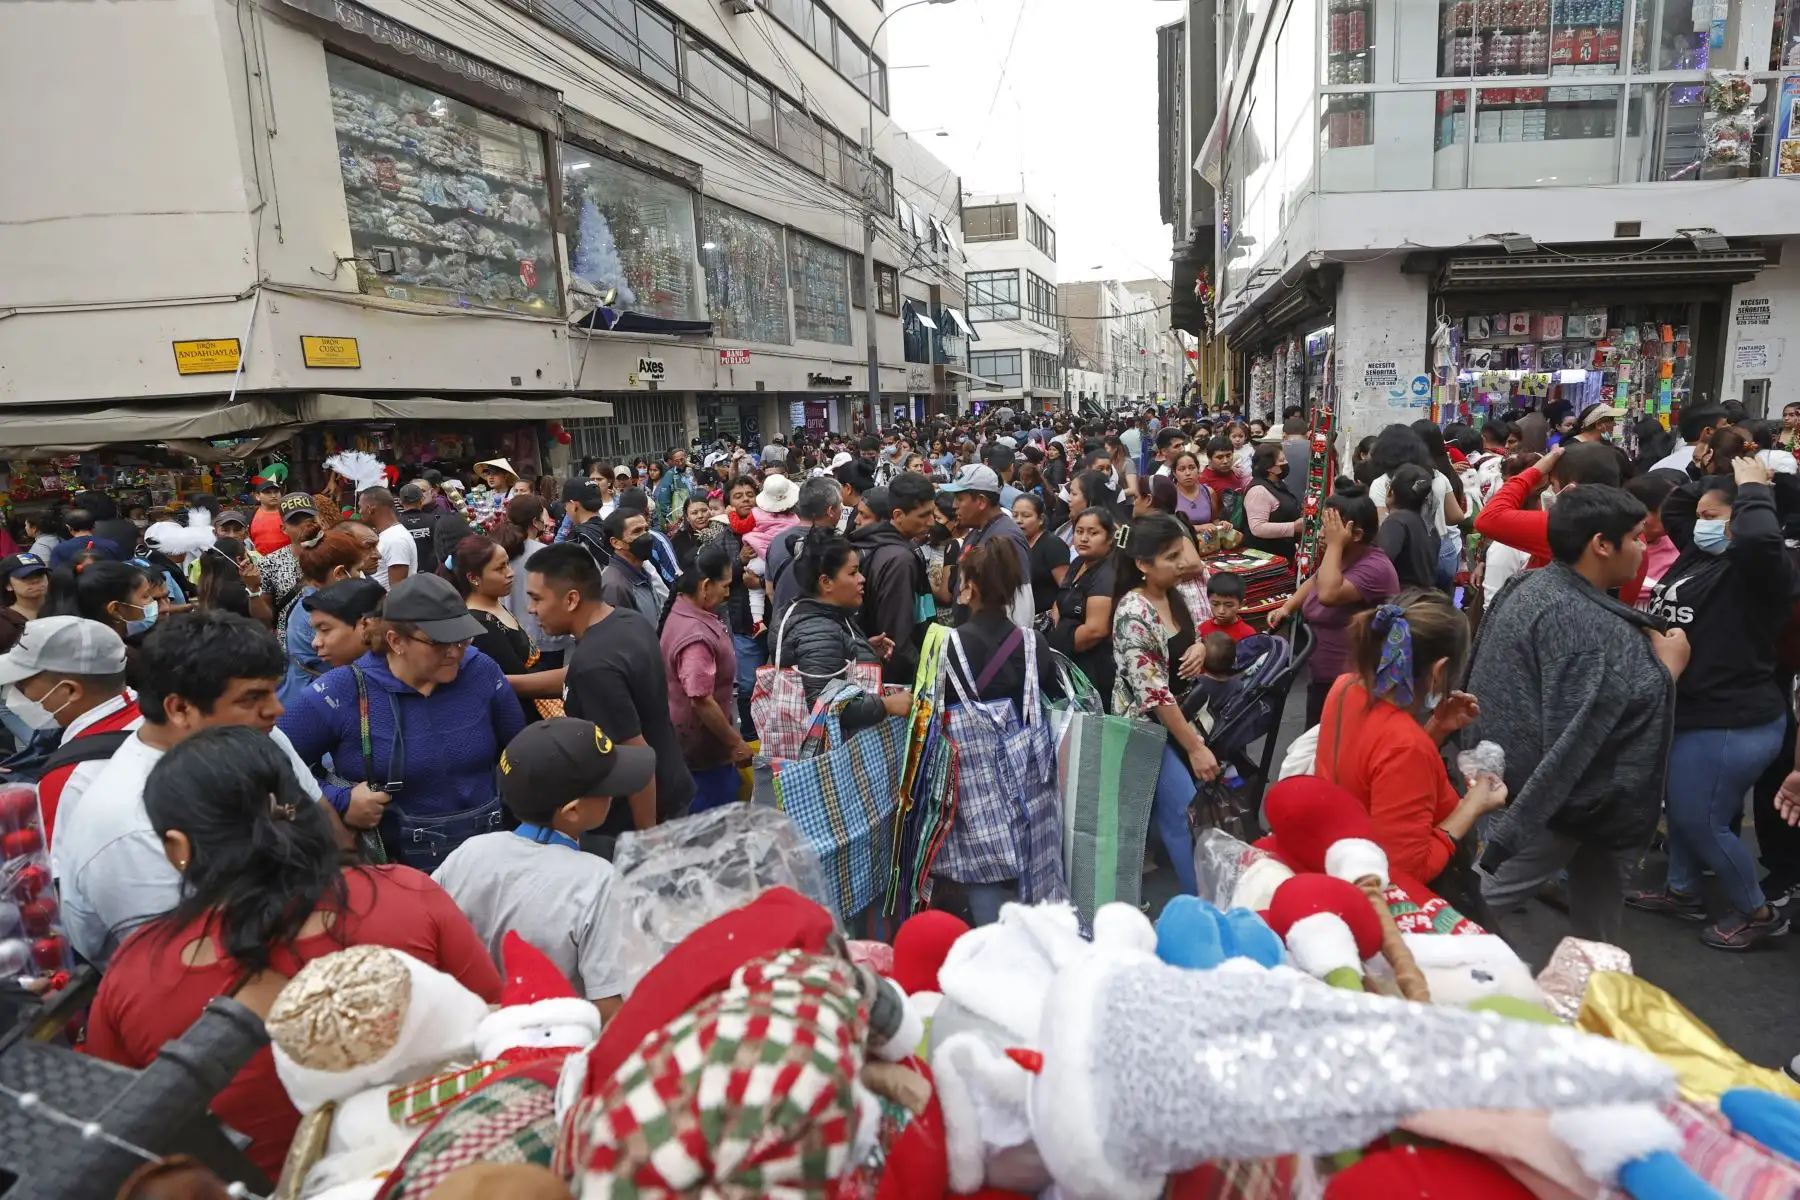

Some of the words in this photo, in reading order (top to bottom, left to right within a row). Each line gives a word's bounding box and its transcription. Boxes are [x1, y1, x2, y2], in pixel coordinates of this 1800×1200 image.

[178, 348, 238, 358] ANDAHUAYLAS
[319, 345, 344, 353] CUSCO
[639, 359, 664, 373] Axes
